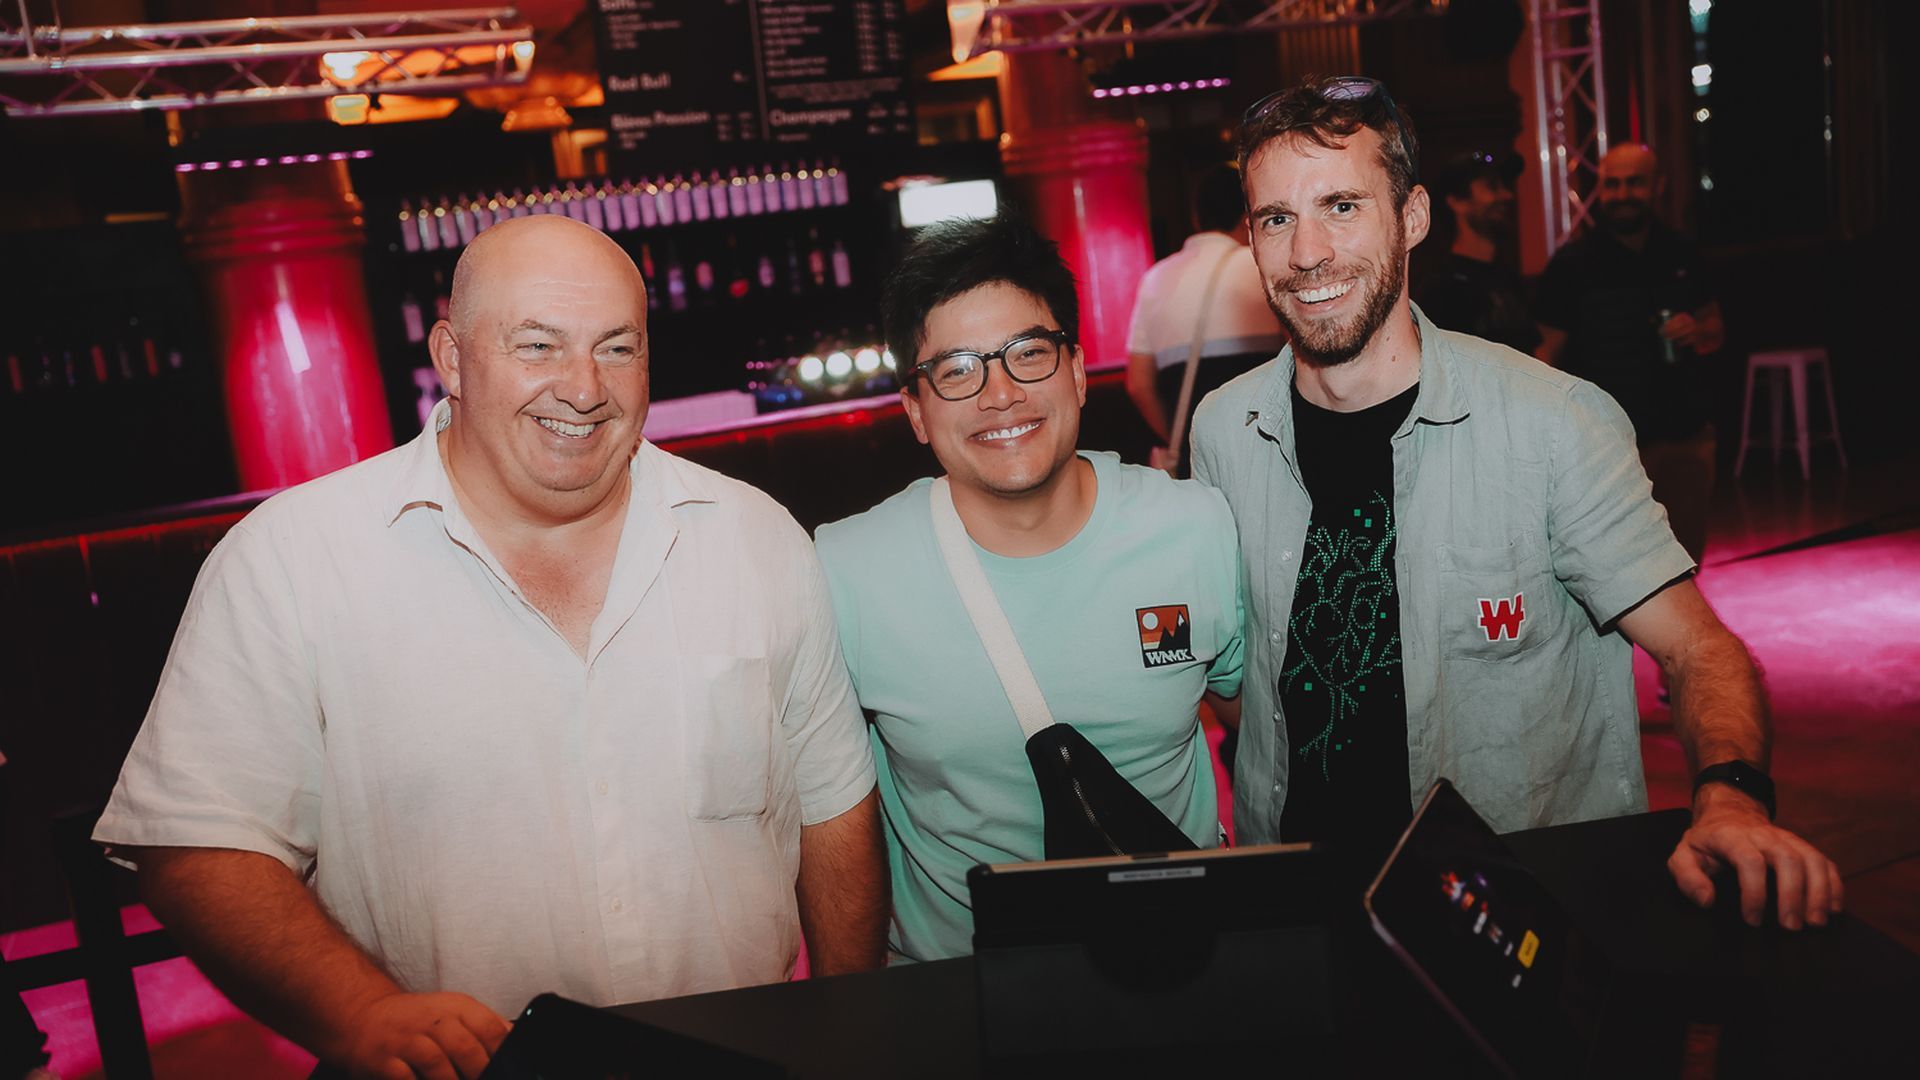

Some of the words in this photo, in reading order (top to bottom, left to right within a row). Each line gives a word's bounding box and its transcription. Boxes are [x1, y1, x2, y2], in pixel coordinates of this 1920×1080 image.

[608, 75, 638, 91] Red
[641, 72, 670, 89] Bull
[769, 108, 852, 126] Champagne
